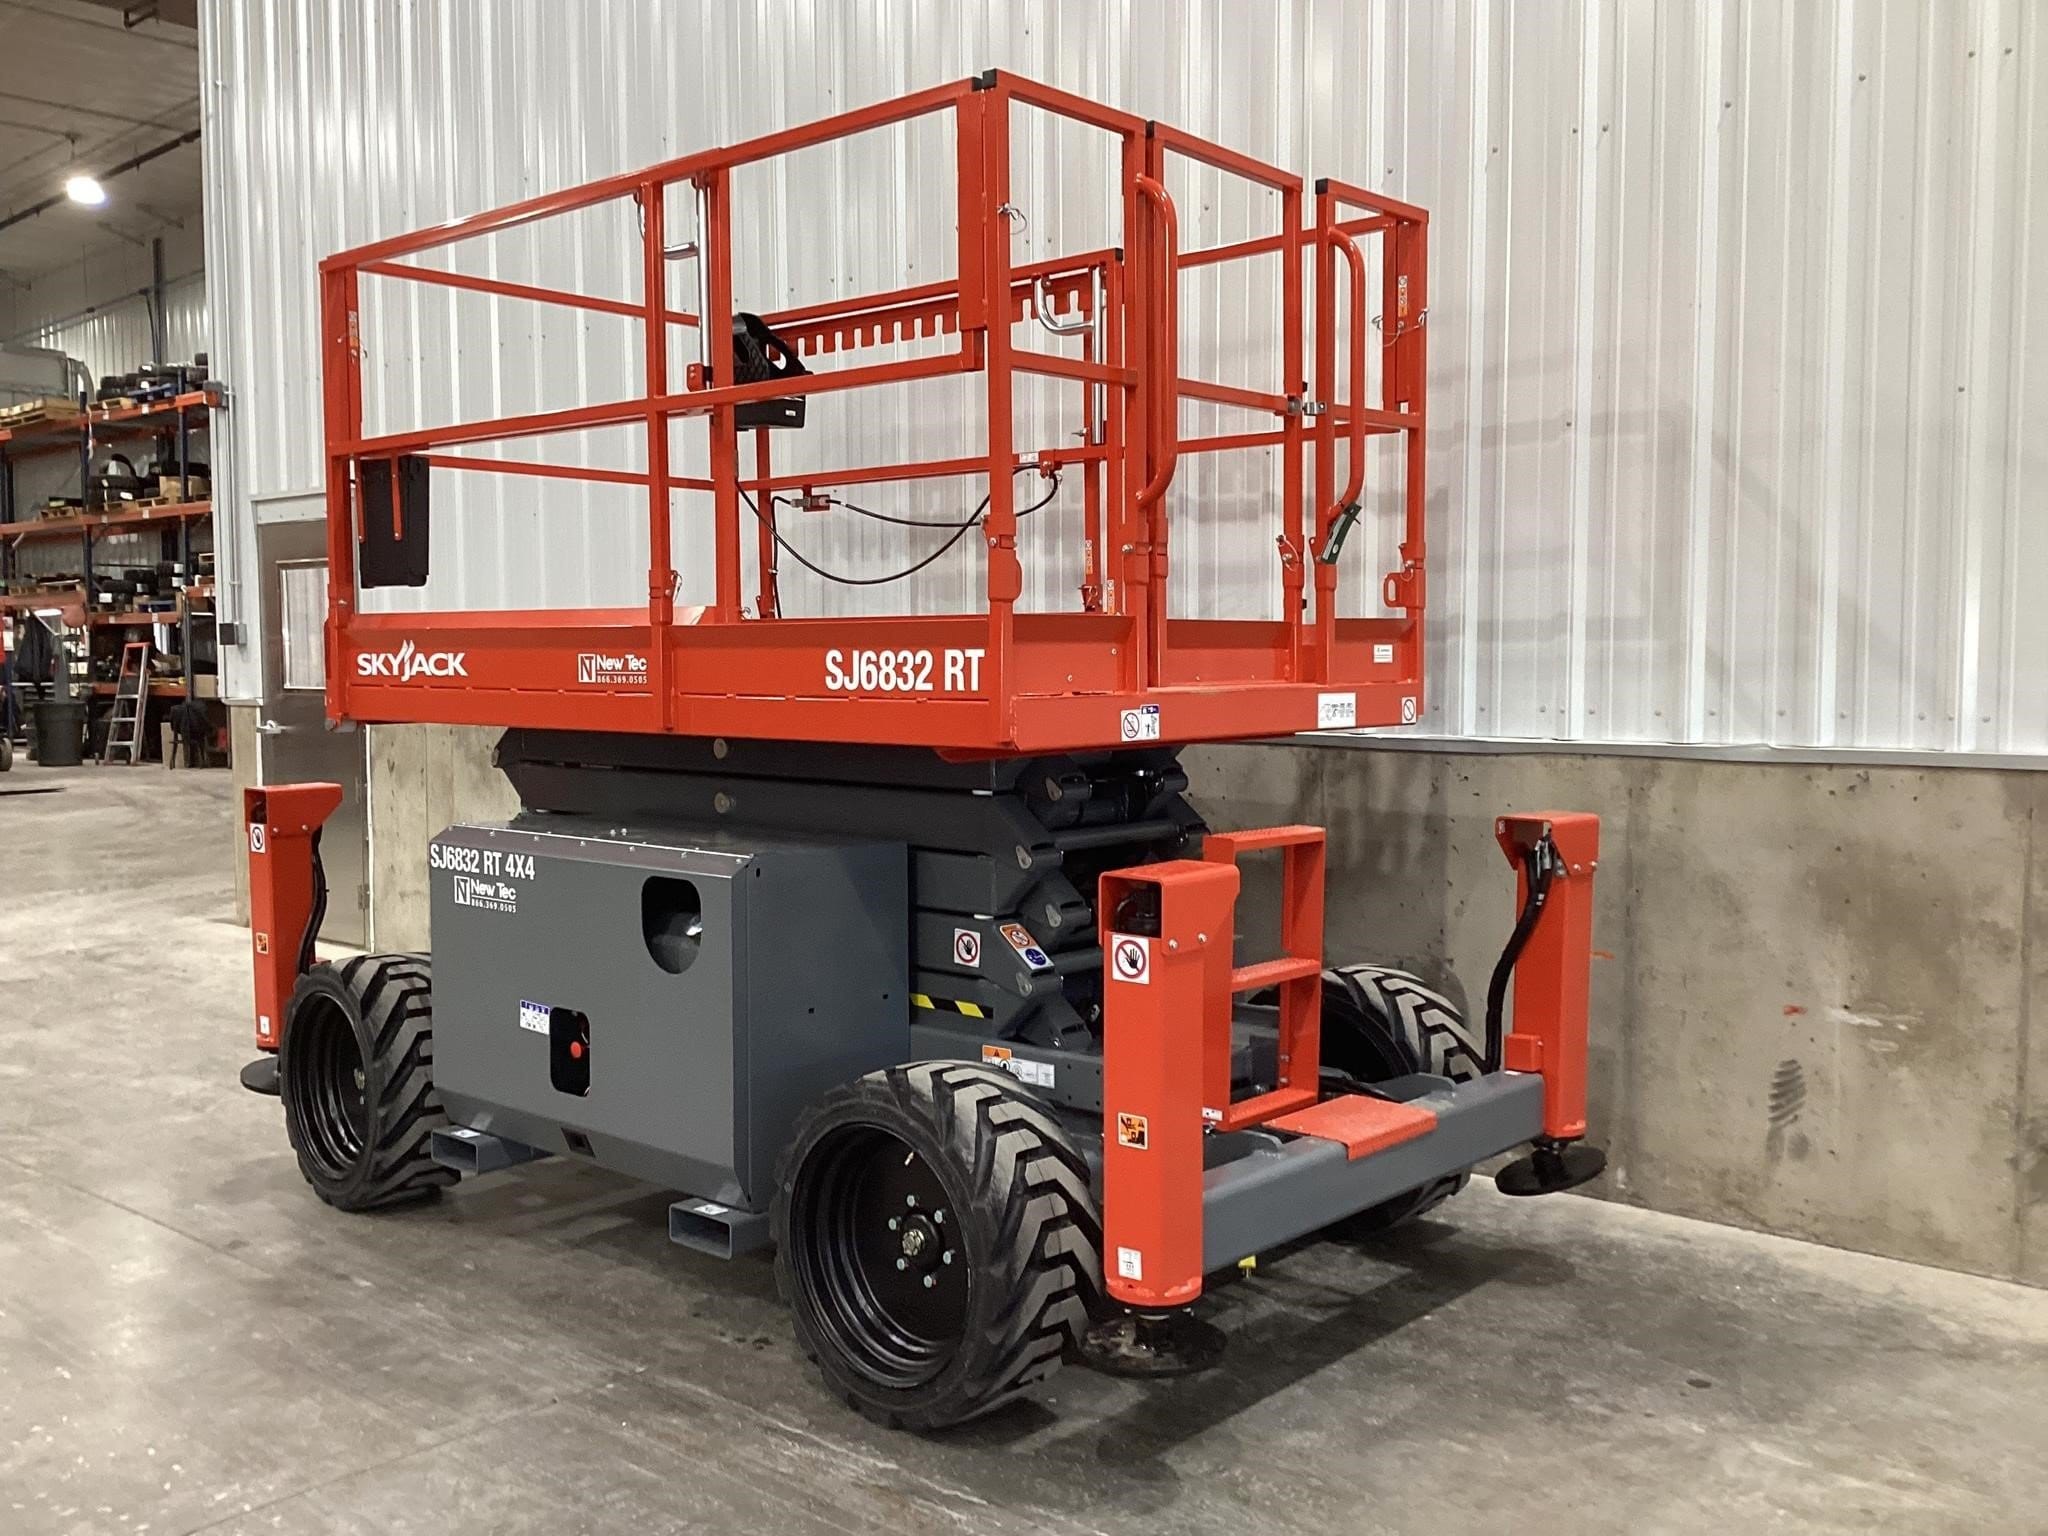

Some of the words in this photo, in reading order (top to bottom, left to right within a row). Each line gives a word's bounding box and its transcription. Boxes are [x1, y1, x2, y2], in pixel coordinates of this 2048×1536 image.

[357, 640, 468, 681] SKYJACK
[596, 654, 624, 671] New
[625, 654, 647, 671] Tec
[825, 648, 934, 691] SJ6832
[944, 648, 985, 691] RT
[430, 843, 480, 873] SJ6832
[483, 850, 502, 876] RT
[505, 853, 535, 880] 4X4
[471, 878, 496, 897] New
[496, 882, 517, 900] Tec
